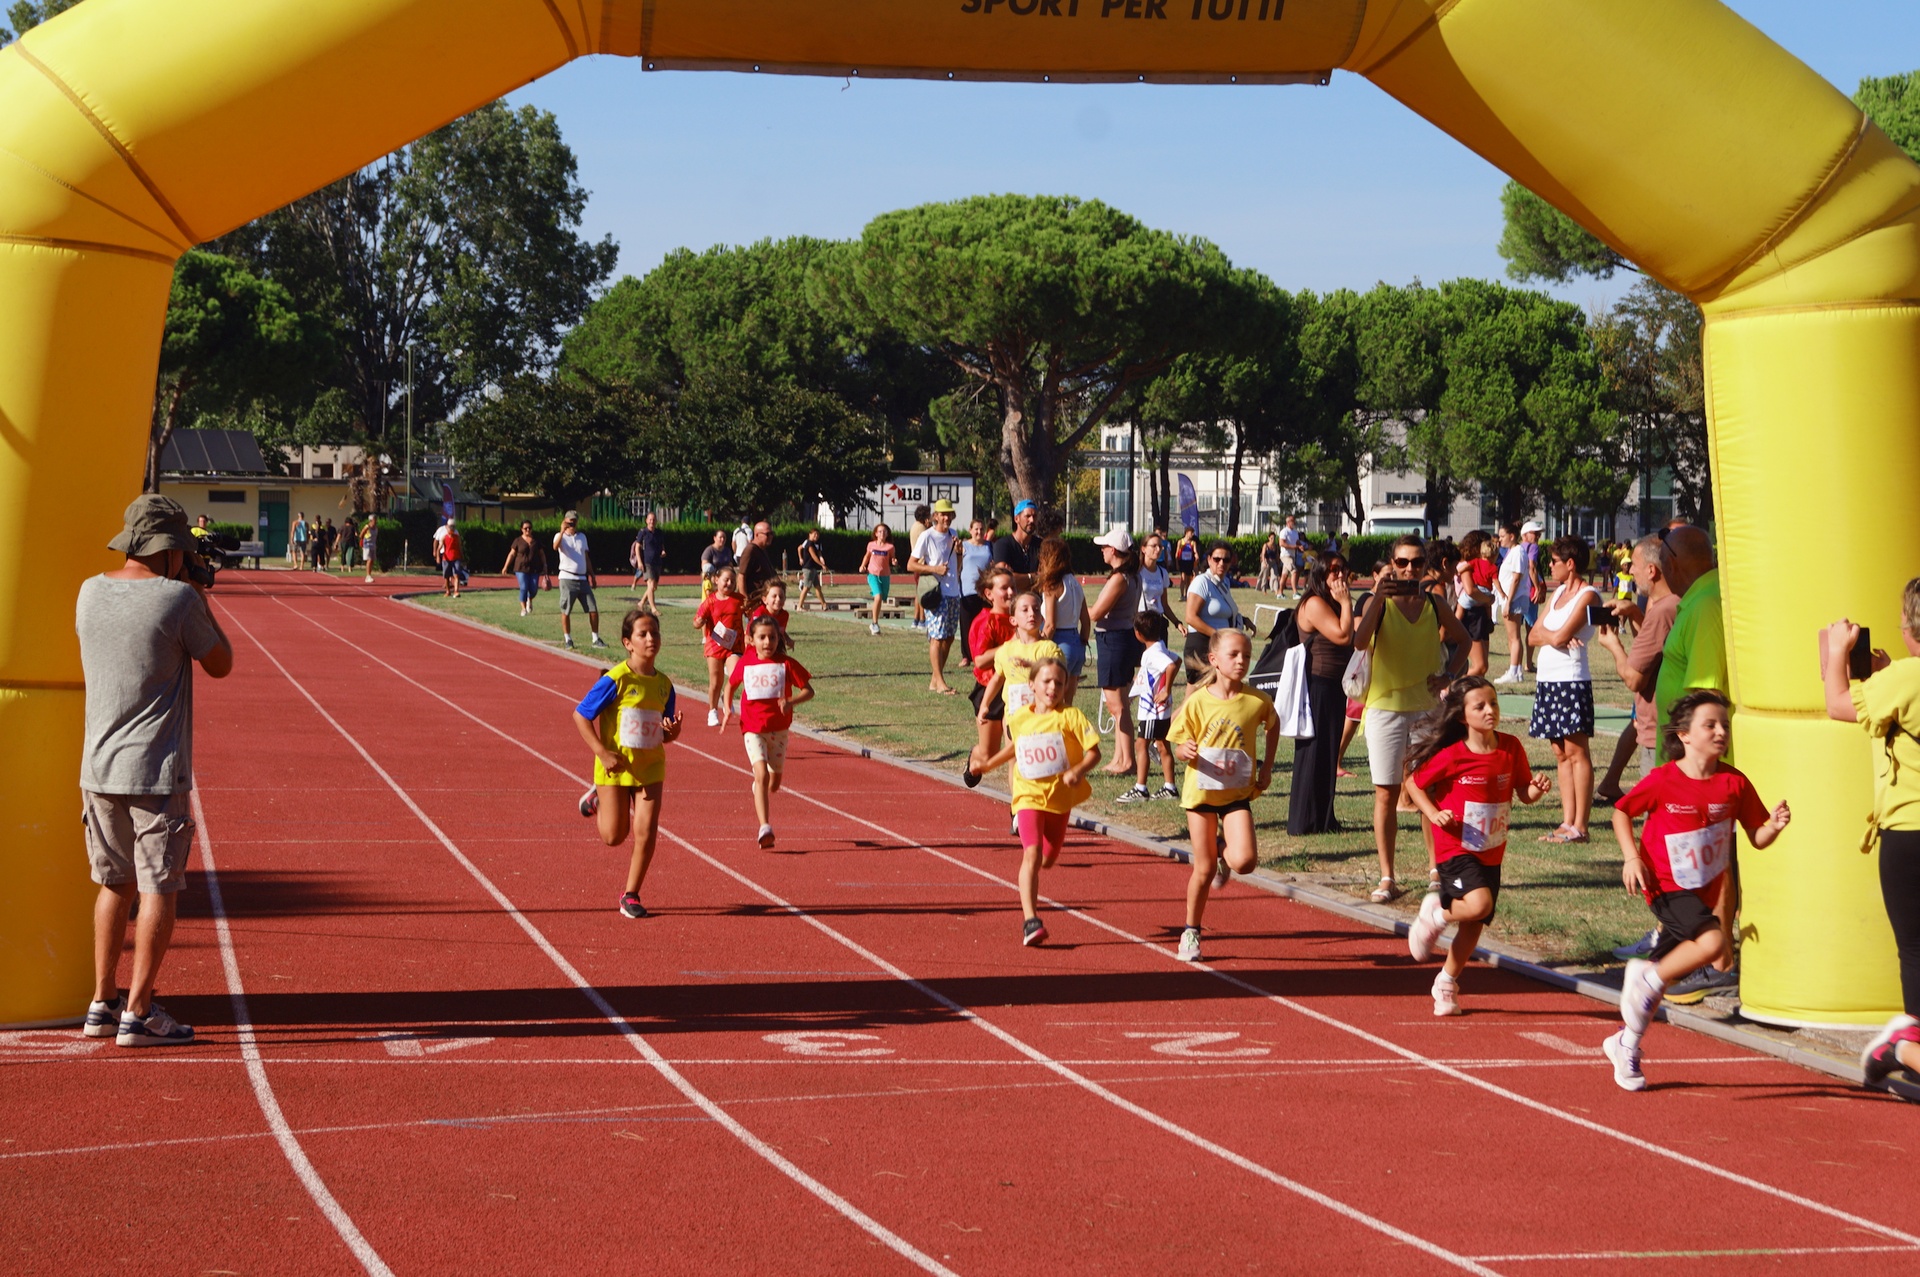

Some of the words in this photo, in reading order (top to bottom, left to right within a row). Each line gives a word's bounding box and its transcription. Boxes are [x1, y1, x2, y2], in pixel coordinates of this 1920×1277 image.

[751, 674, 779, 688] 263
[628, 719, 661, 738] 257
[1024, 745, 1058, 766] 500
[1214, 759, 1237, 777] 58
[1685, 838, 1725, 871] 107
